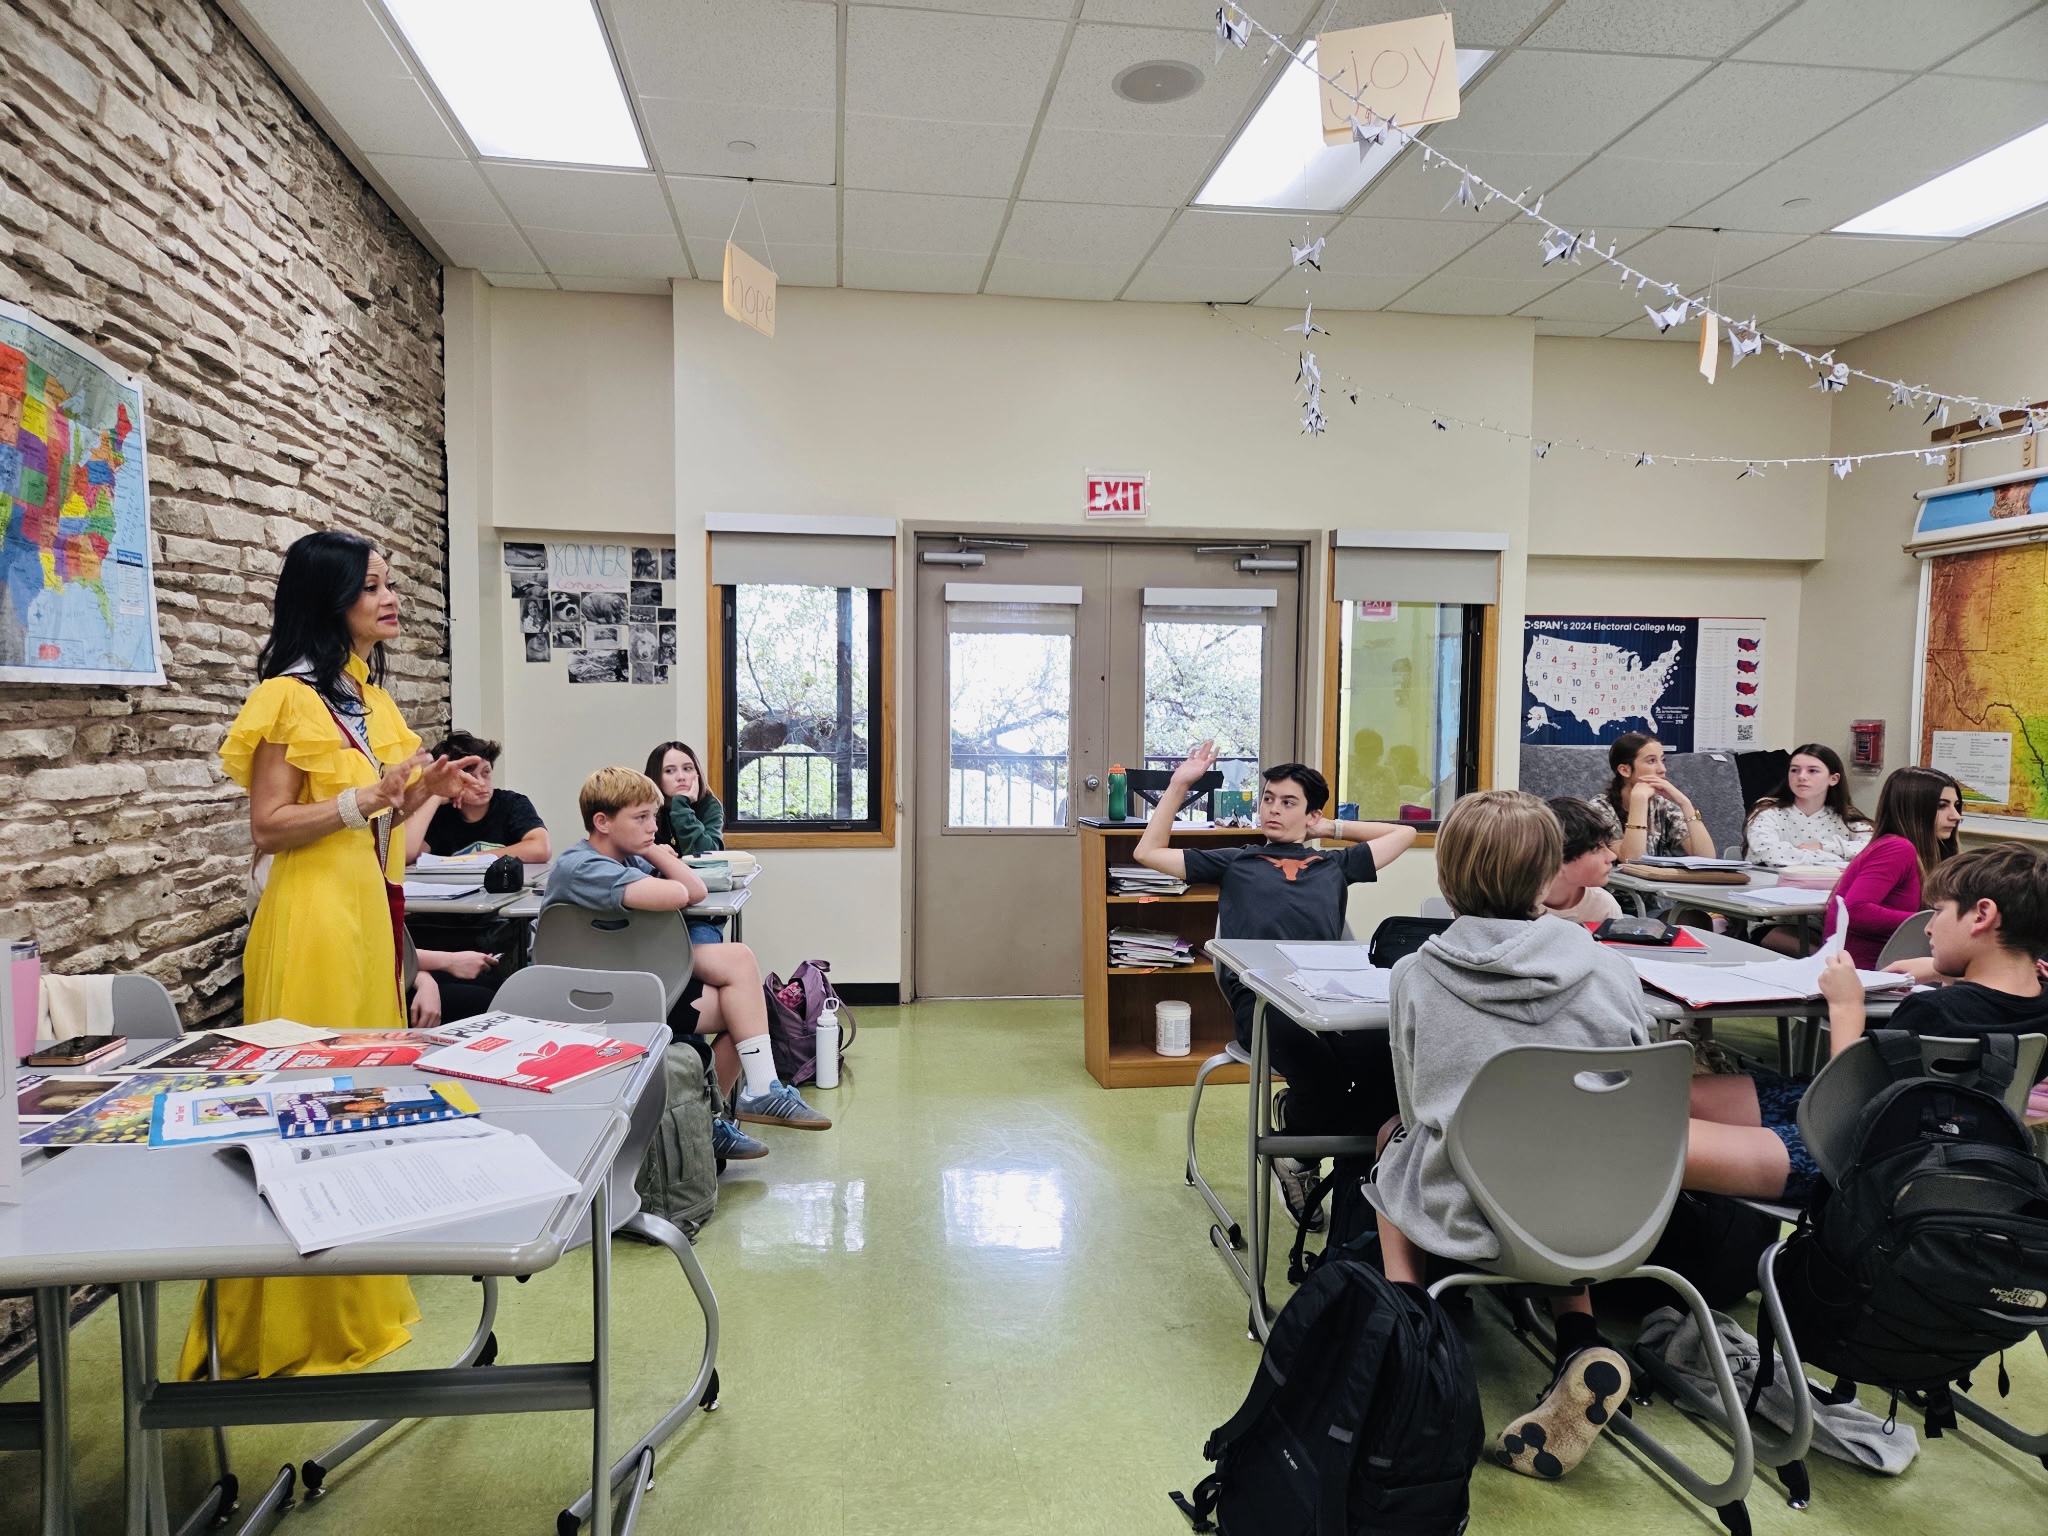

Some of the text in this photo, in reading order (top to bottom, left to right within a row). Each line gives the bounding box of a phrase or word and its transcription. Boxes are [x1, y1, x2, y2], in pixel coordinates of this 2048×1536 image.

[730, 247, 775, 327] hope
[1089, 481, 1144, 511] EXIT
[1569, 622, 1592, 631] 2024
[1593, 622, 1632, 631] Electoral
[1633, 623, 1666, 634] College
[1667, 624, 1687, 634] Map
